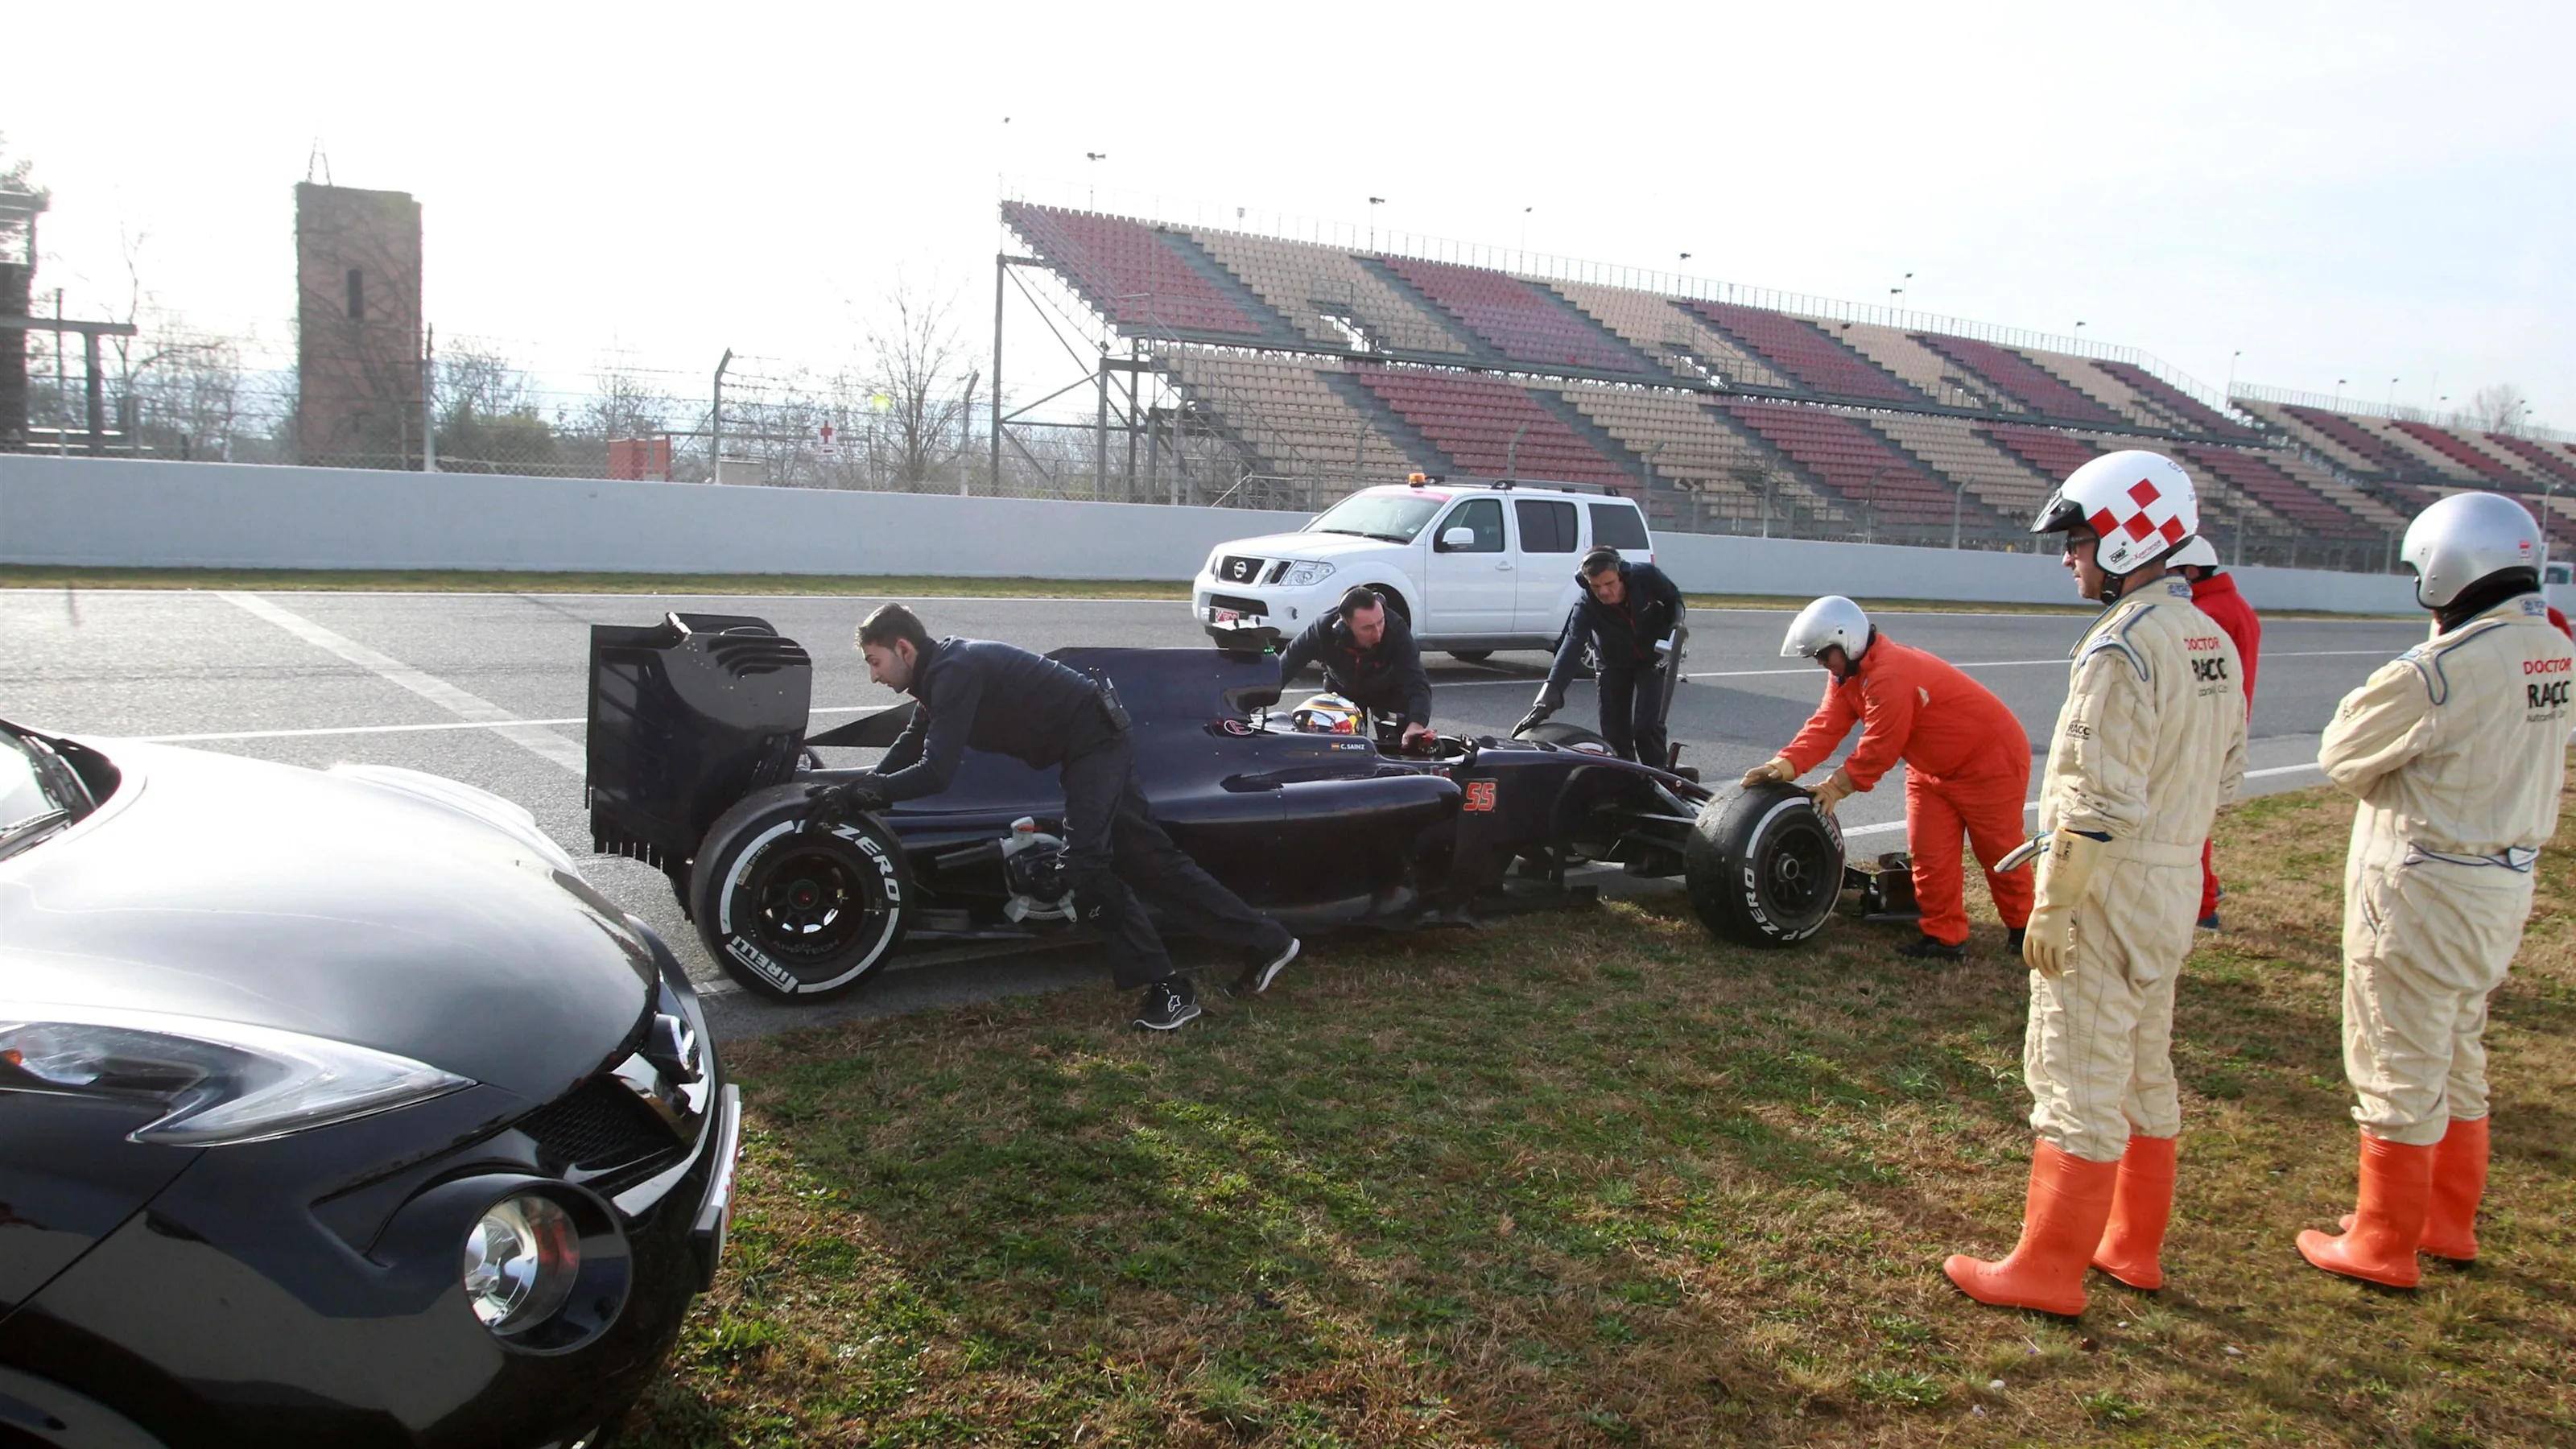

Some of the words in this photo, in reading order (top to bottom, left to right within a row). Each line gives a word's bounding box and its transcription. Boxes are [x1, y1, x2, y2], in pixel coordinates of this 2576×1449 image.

[2110, 549, 2127, 564] OMP
[2184, 638, 2220, 651] DOCTOR
[2191, 657, 2227, 682] RACC
[2523, 658, 2572, 675] DOCTOR
[2528, 680, 2570, 708] RACC
[2068, 724, 2091, 736] RACC
[1463, 782, 1496, 811] 55
[831, 823, 901, 902] ZERO
[1744, 867, 1780, 935] ZERO
[1781, 930, 1800, 941] P
[725, 935, 799, 994] PIRELLI
